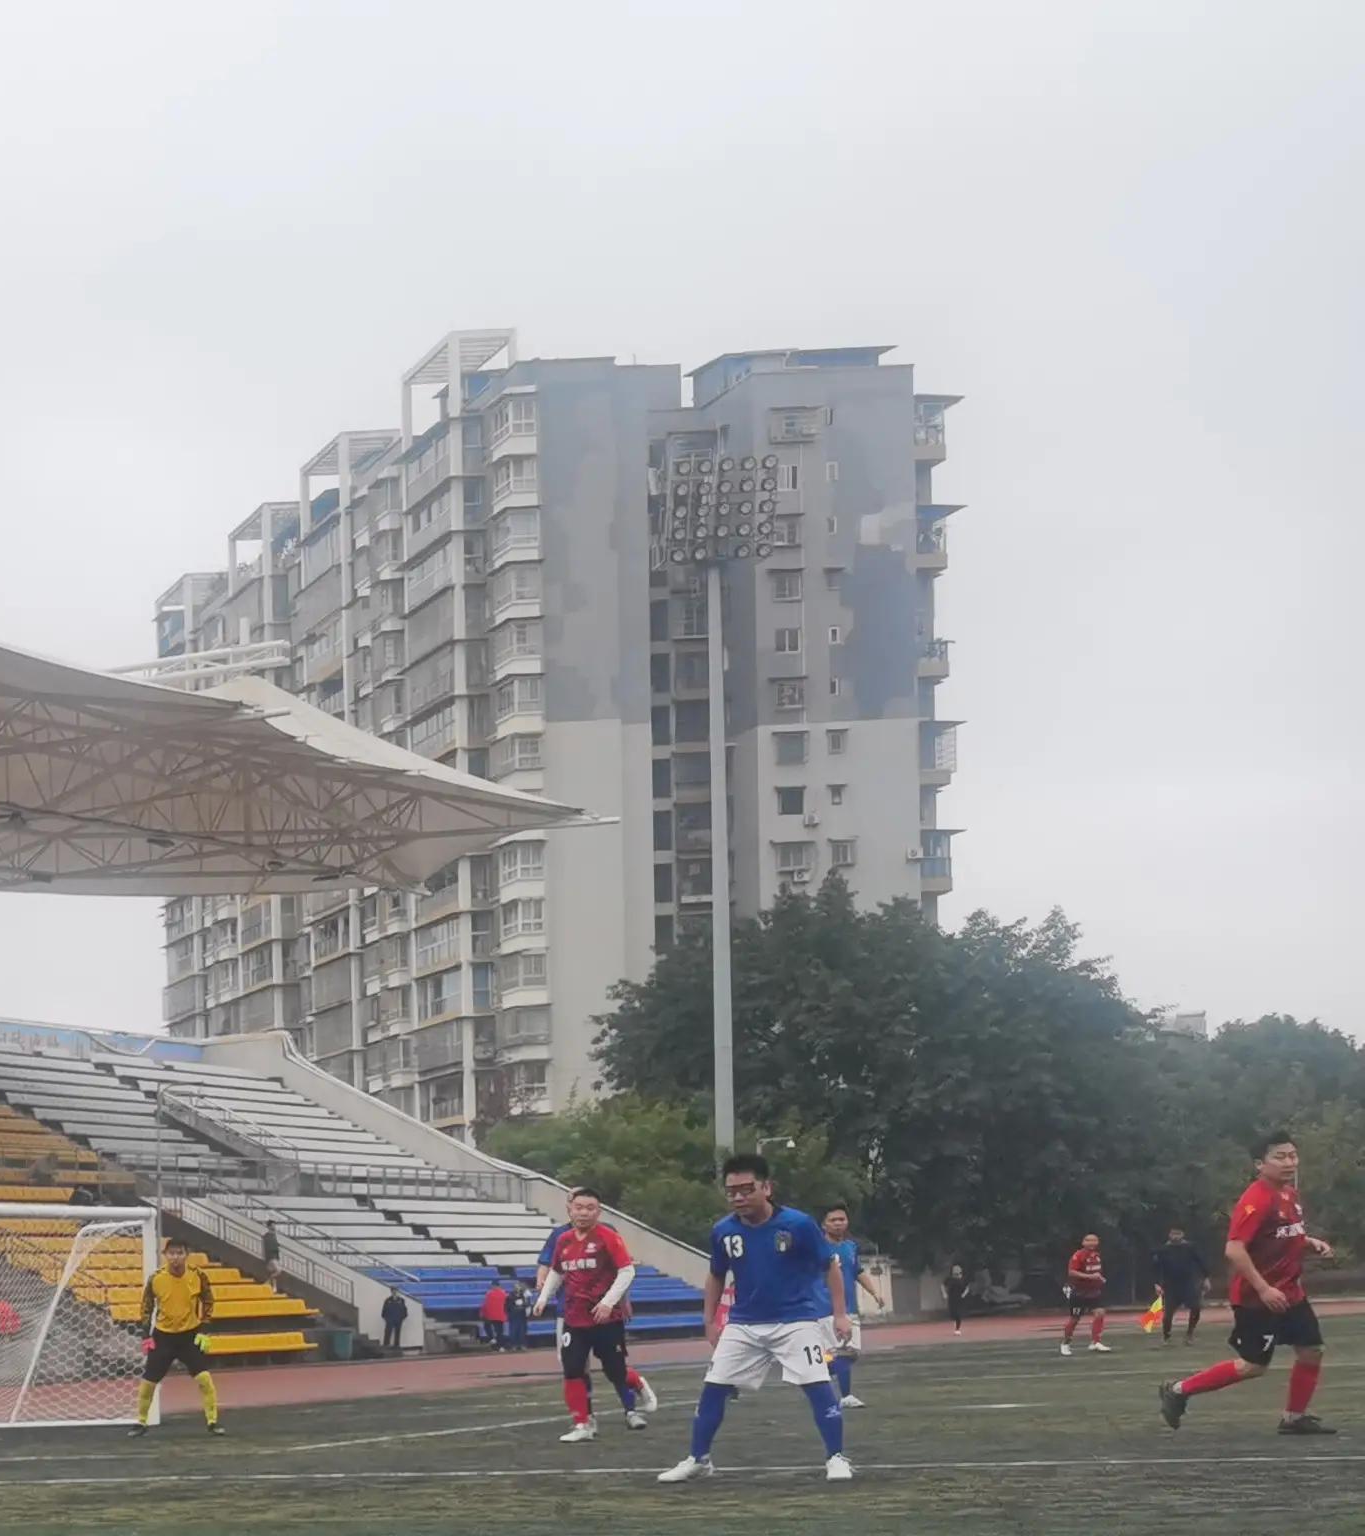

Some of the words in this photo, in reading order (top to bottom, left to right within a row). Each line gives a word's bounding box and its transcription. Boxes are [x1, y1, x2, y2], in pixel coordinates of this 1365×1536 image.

[722, 1234, 744, 1259] 13
[1262, 1334, 1275, 1352] 7
[802, 1345, 824, 1366] 13
